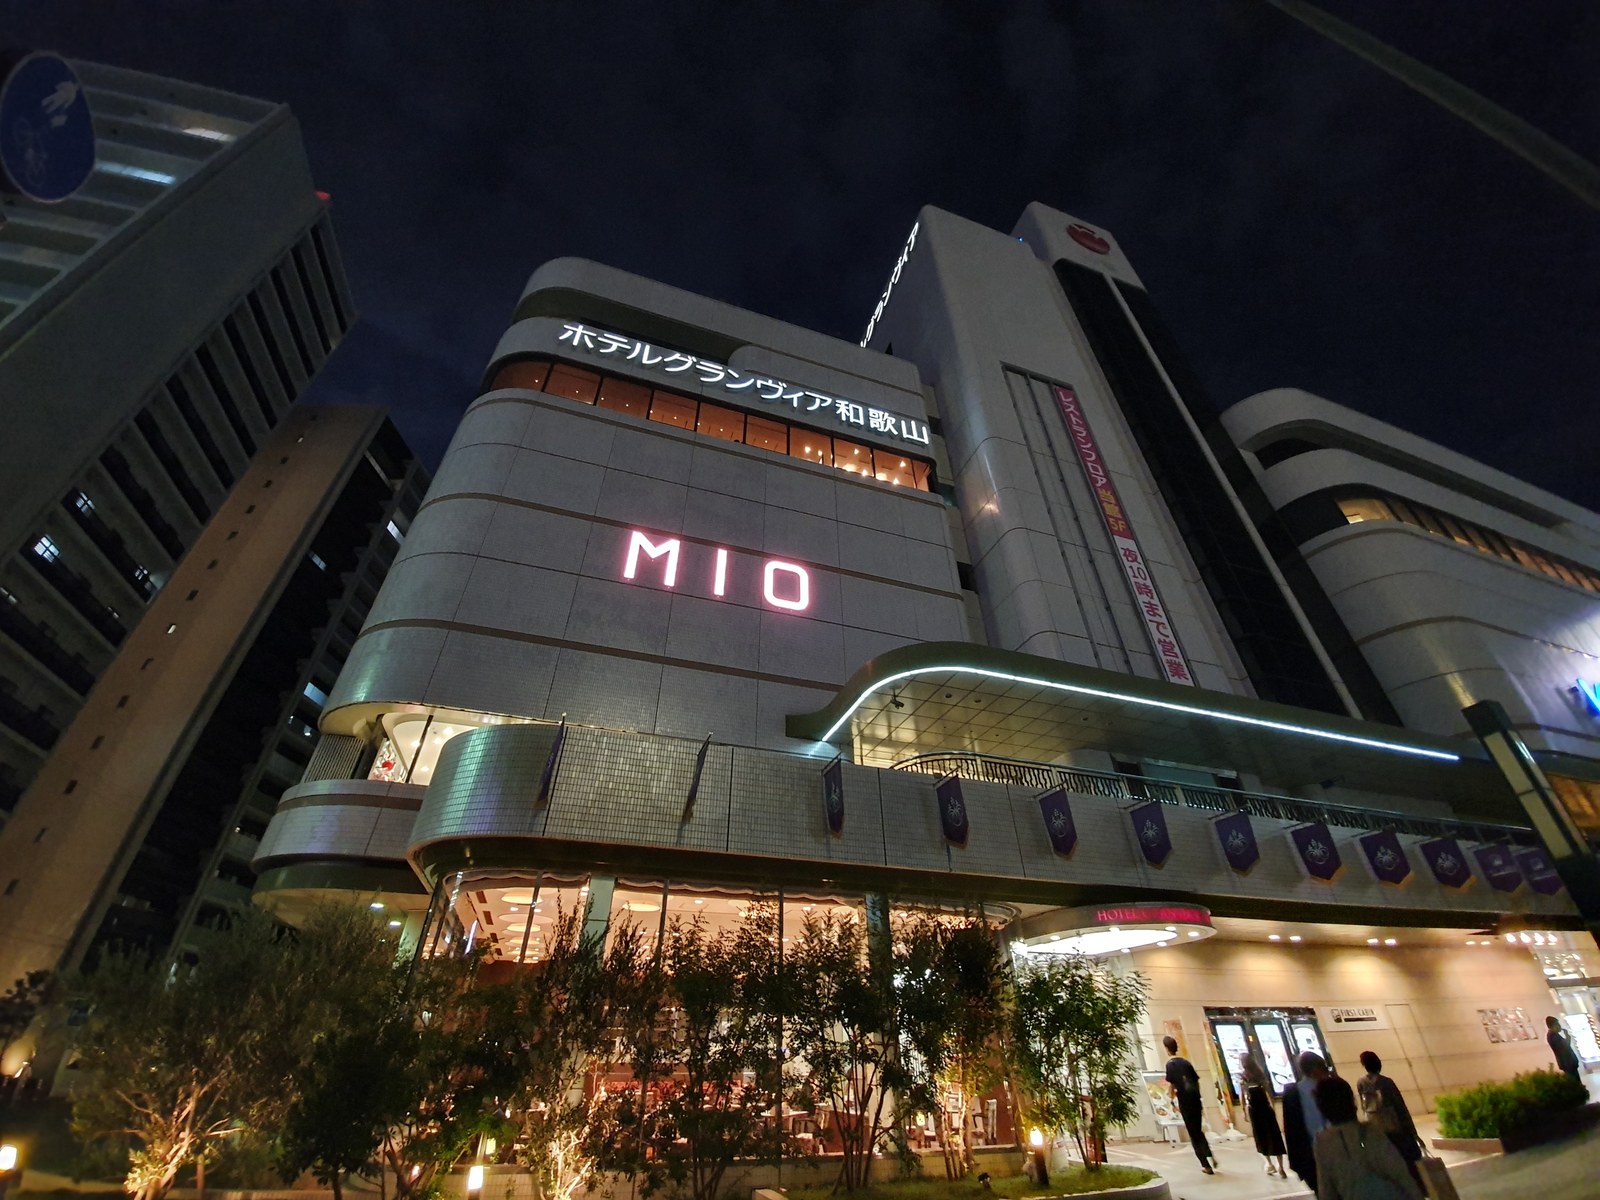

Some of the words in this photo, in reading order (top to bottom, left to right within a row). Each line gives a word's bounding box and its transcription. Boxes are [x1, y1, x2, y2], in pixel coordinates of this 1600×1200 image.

[558, 323, 930, 445] ホテルグランヴィア和歌山
[623, 530, 809, 611] MIO
[1121, 547, 1189, 681] 夜10時まで営業
